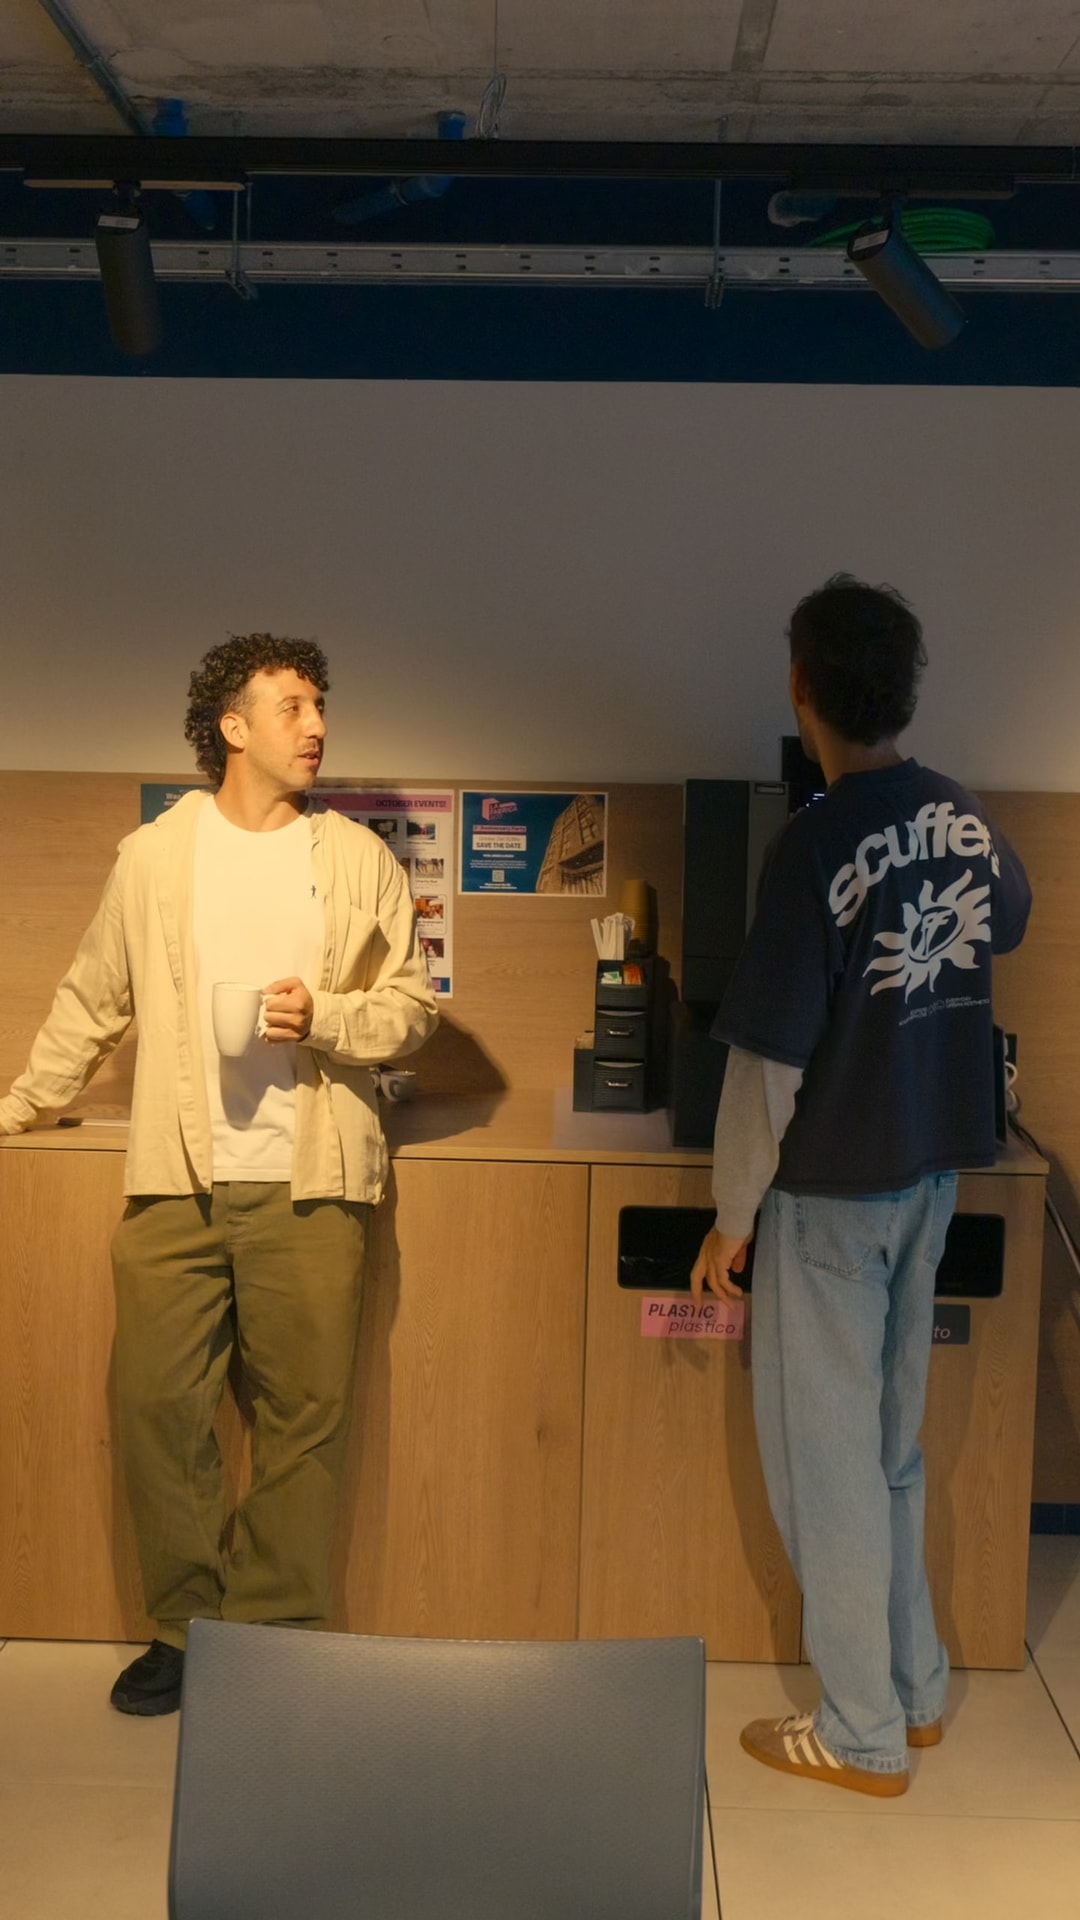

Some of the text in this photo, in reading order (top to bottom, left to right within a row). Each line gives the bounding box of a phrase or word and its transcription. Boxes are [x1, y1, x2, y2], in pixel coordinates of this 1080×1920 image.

[376, 800, 447, 808] OCTOBER EVENTS!
[505, 842, 521, 850] DATE
[648, 1303, 715, 1319] PLASTIC
